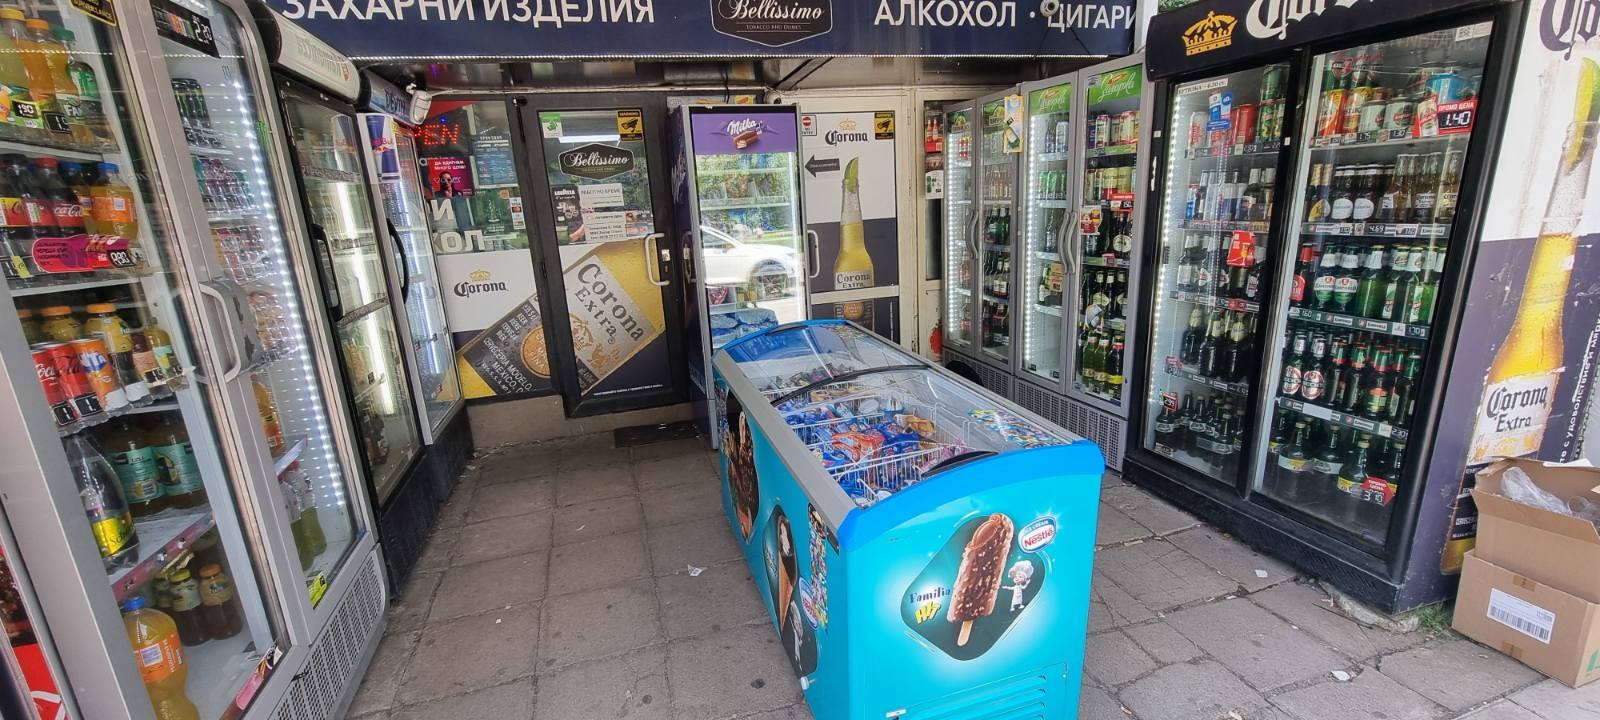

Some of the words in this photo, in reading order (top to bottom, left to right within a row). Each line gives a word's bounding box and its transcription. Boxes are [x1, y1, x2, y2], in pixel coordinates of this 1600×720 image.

[282, 0, 475, 21] ЗАХАРНИ
[485, 0, 655, 28] ИЗДЕЛИЯ
[718, 0, 824, 19] Bellissimo
[874, 0, 1016, 27] АЛКОХОЛ
[727, 118, 757, 136] Milka
[1444, 111, 1471, 127] 1.40
[824, 129, 868, 146] Corona
[564, 151, 629, 167] Bellissimo
[837, 273, 871, 284] Corona
[454, 280, 508, 299] Corona
[577, 263, 646, 343] Corona
[574, 286, 617, 340] Extra
[1486, 386, 1549, 419] Corona
[1495, 413, 1532, 433] Extra
[1024, 527, 1054, 547] Nestlé
[909, 586, 951, 604] Familia
